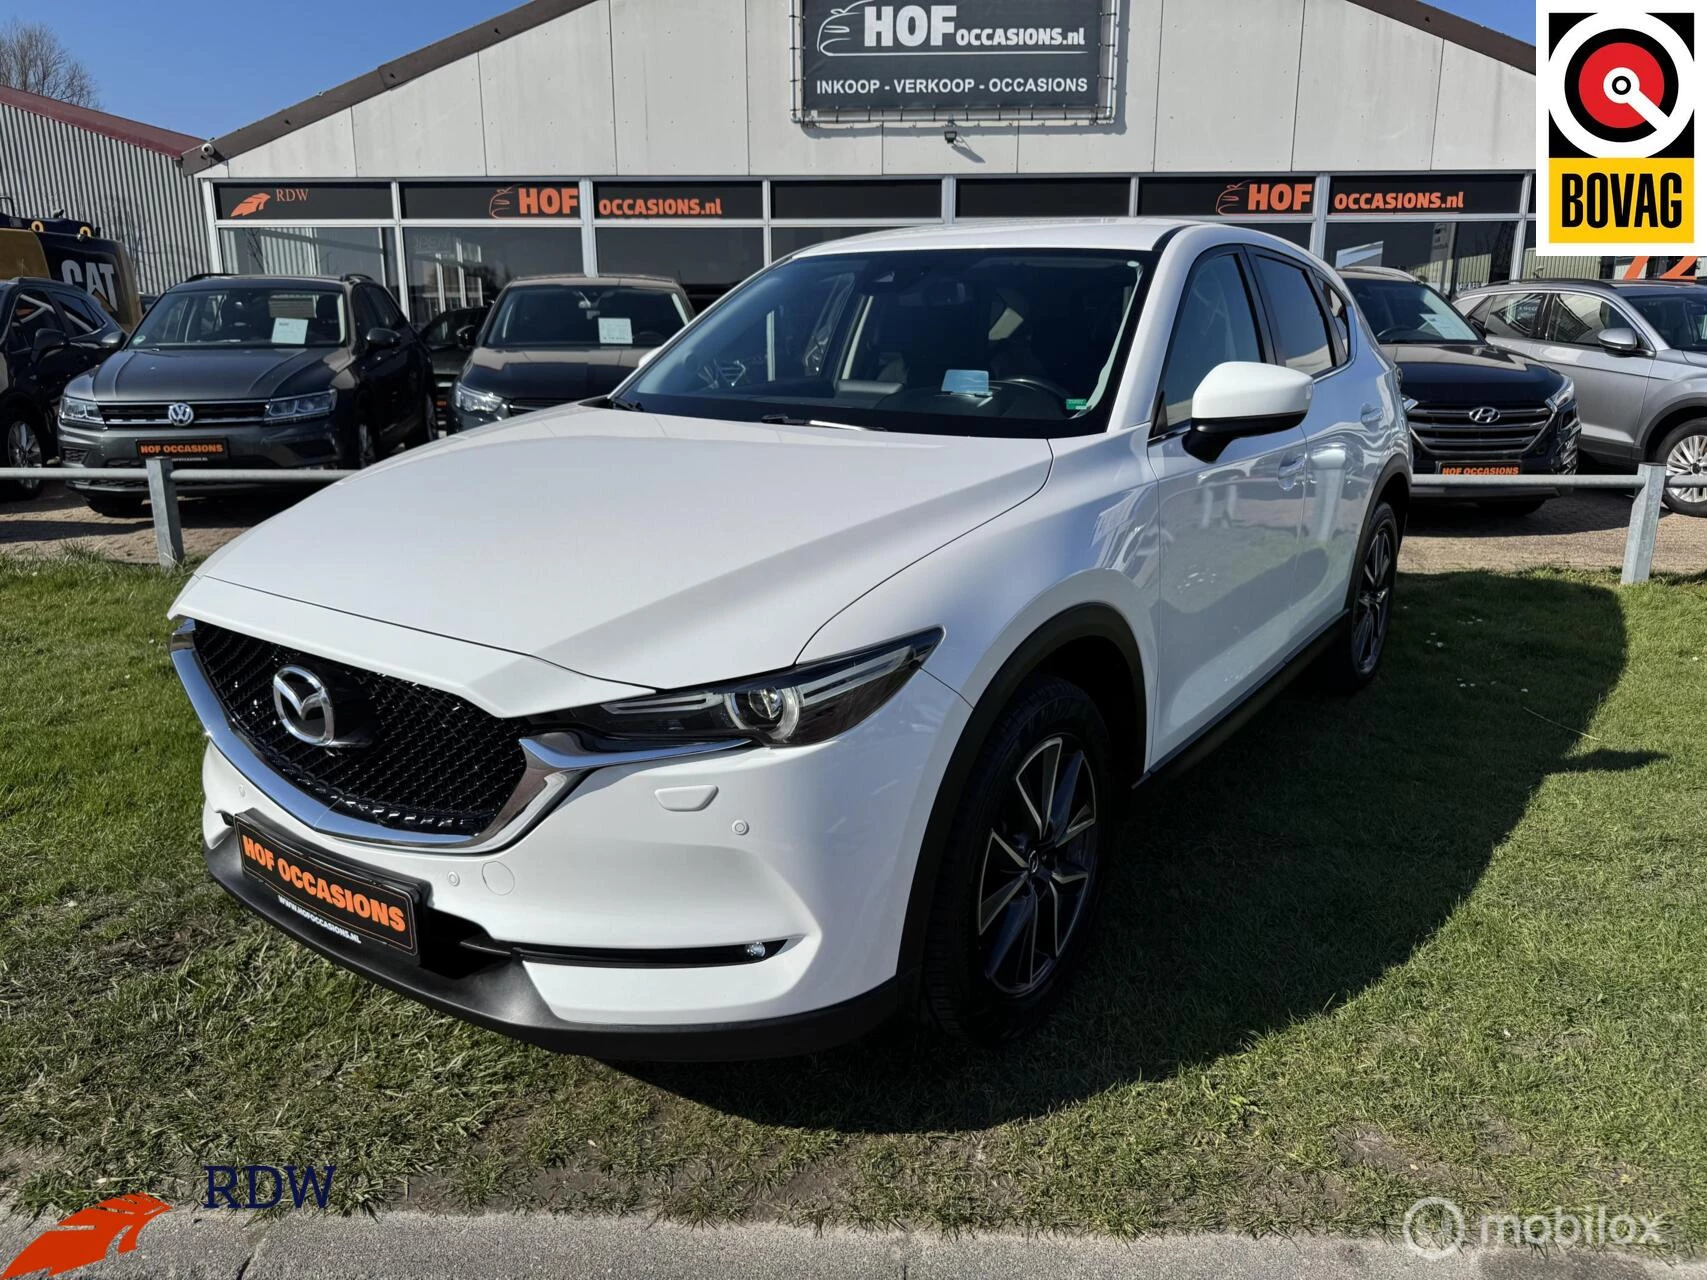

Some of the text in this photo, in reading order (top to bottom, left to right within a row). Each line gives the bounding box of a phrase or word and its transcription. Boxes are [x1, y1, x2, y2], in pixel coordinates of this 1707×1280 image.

[864, 5, 1085, 47] HOF OCCASIONS.nl
[816, 80, 880, 95] INKOOP
[894, 79, 975, 94] VERKOOP
[988, 78, 1088, 93] OCCASIONS
[275, 188, 309, 202] RDW
[518, 187, 722, 216] HOF OCCASIONS.nl
[1247, 183, 1464, 212] HOF OCCASIONS.nl
[140, 444, 223, 454] HOF OCCASIONS
[1442, 467, 1519, 475] HOF OCCASIONS
[242, 835, 406, 933] HOF OCCASIONS
